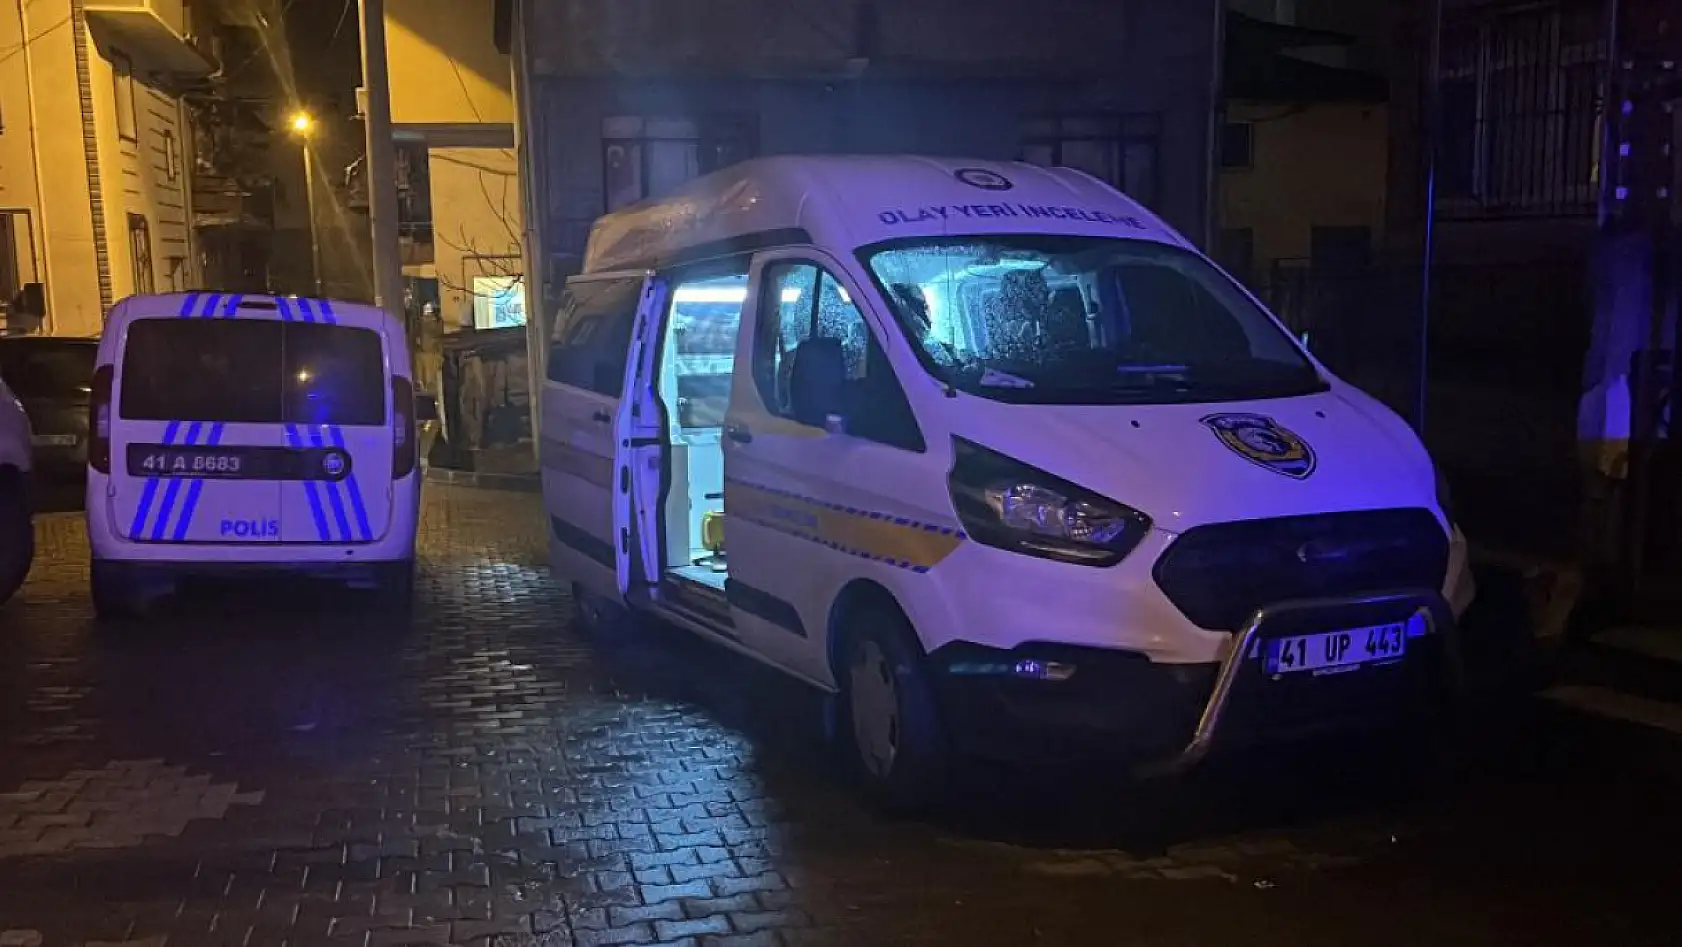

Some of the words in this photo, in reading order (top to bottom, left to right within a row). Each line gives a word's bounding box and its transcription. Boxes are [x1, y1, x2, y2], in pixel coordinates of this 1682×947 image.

[879, 205, 948, 225] OLAY
[142, 455, 166, 470] 41
[173, 456, 186, 470] A
[1282, 638, 1306, 667] 41
[1326, 633, 1350, 662] UP
[1366, 625, 1401, 656] 443
